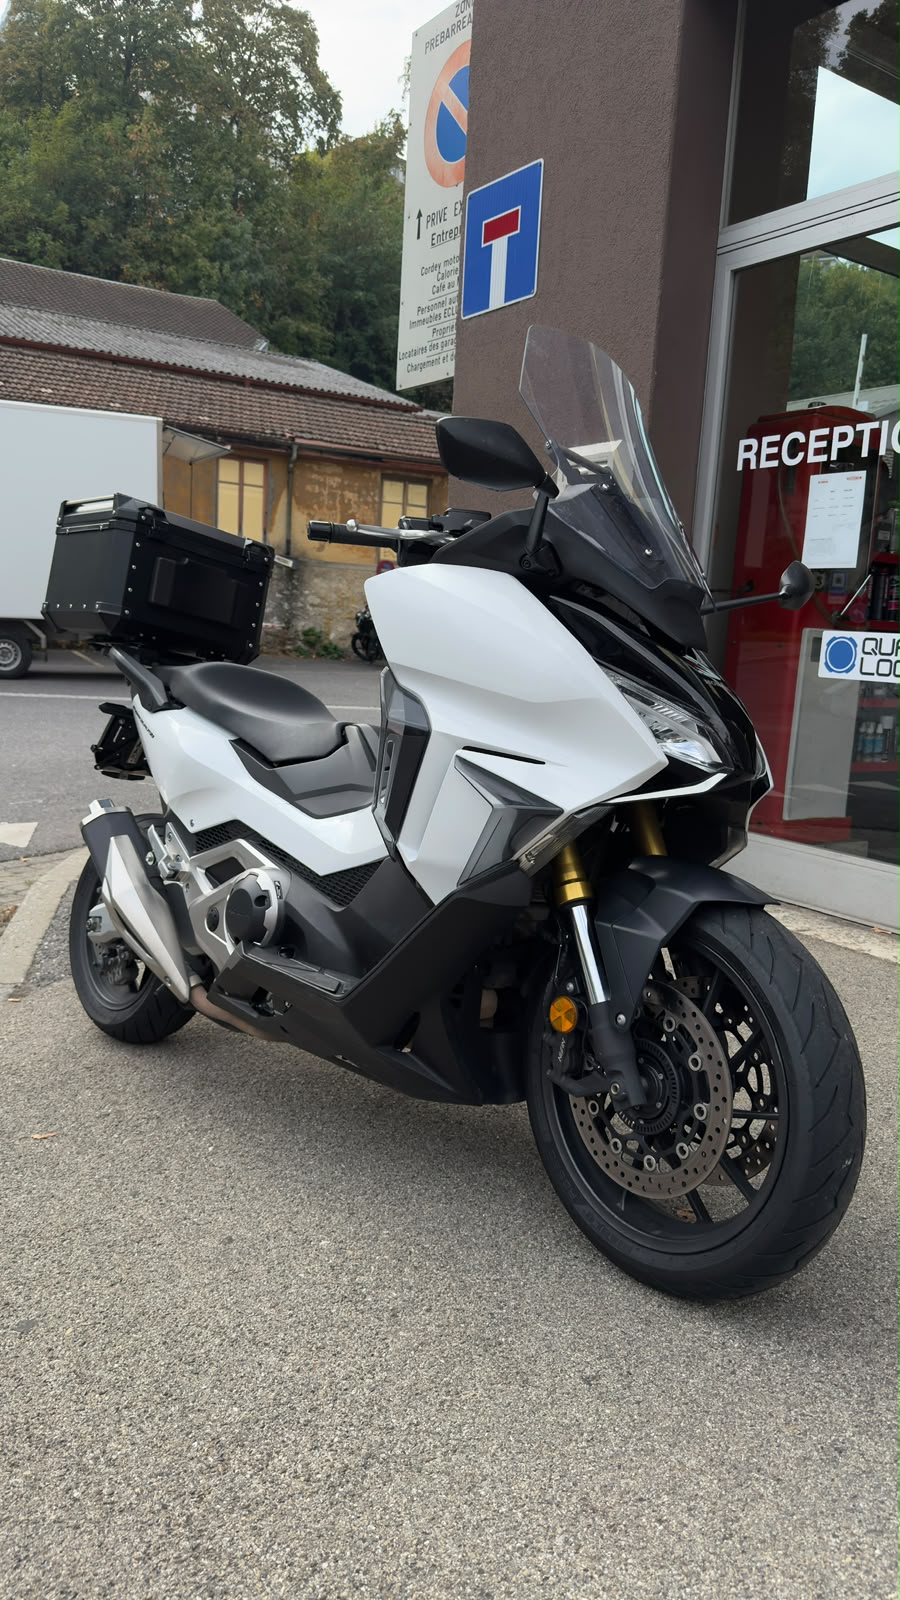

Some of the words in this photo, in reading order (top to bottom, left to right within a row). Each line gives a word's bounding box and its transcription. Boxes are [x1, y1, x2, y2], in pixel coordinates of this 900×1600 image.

[455, 0, 474, 18] ZON
[425, 207, 448, 229] PRIVE
[421, 262, 442, 276] Cordey
[431, 281, 446, 295] Café
[417, 297, 447, 316] Personnel
[409, 312, 442, 330] Immeubles
[398, 346, 428, 361] Locataires
[428, 342, 439, 352] des
[406, 357, 441, 373] Chargement
[442, 353, 449, 364] et
